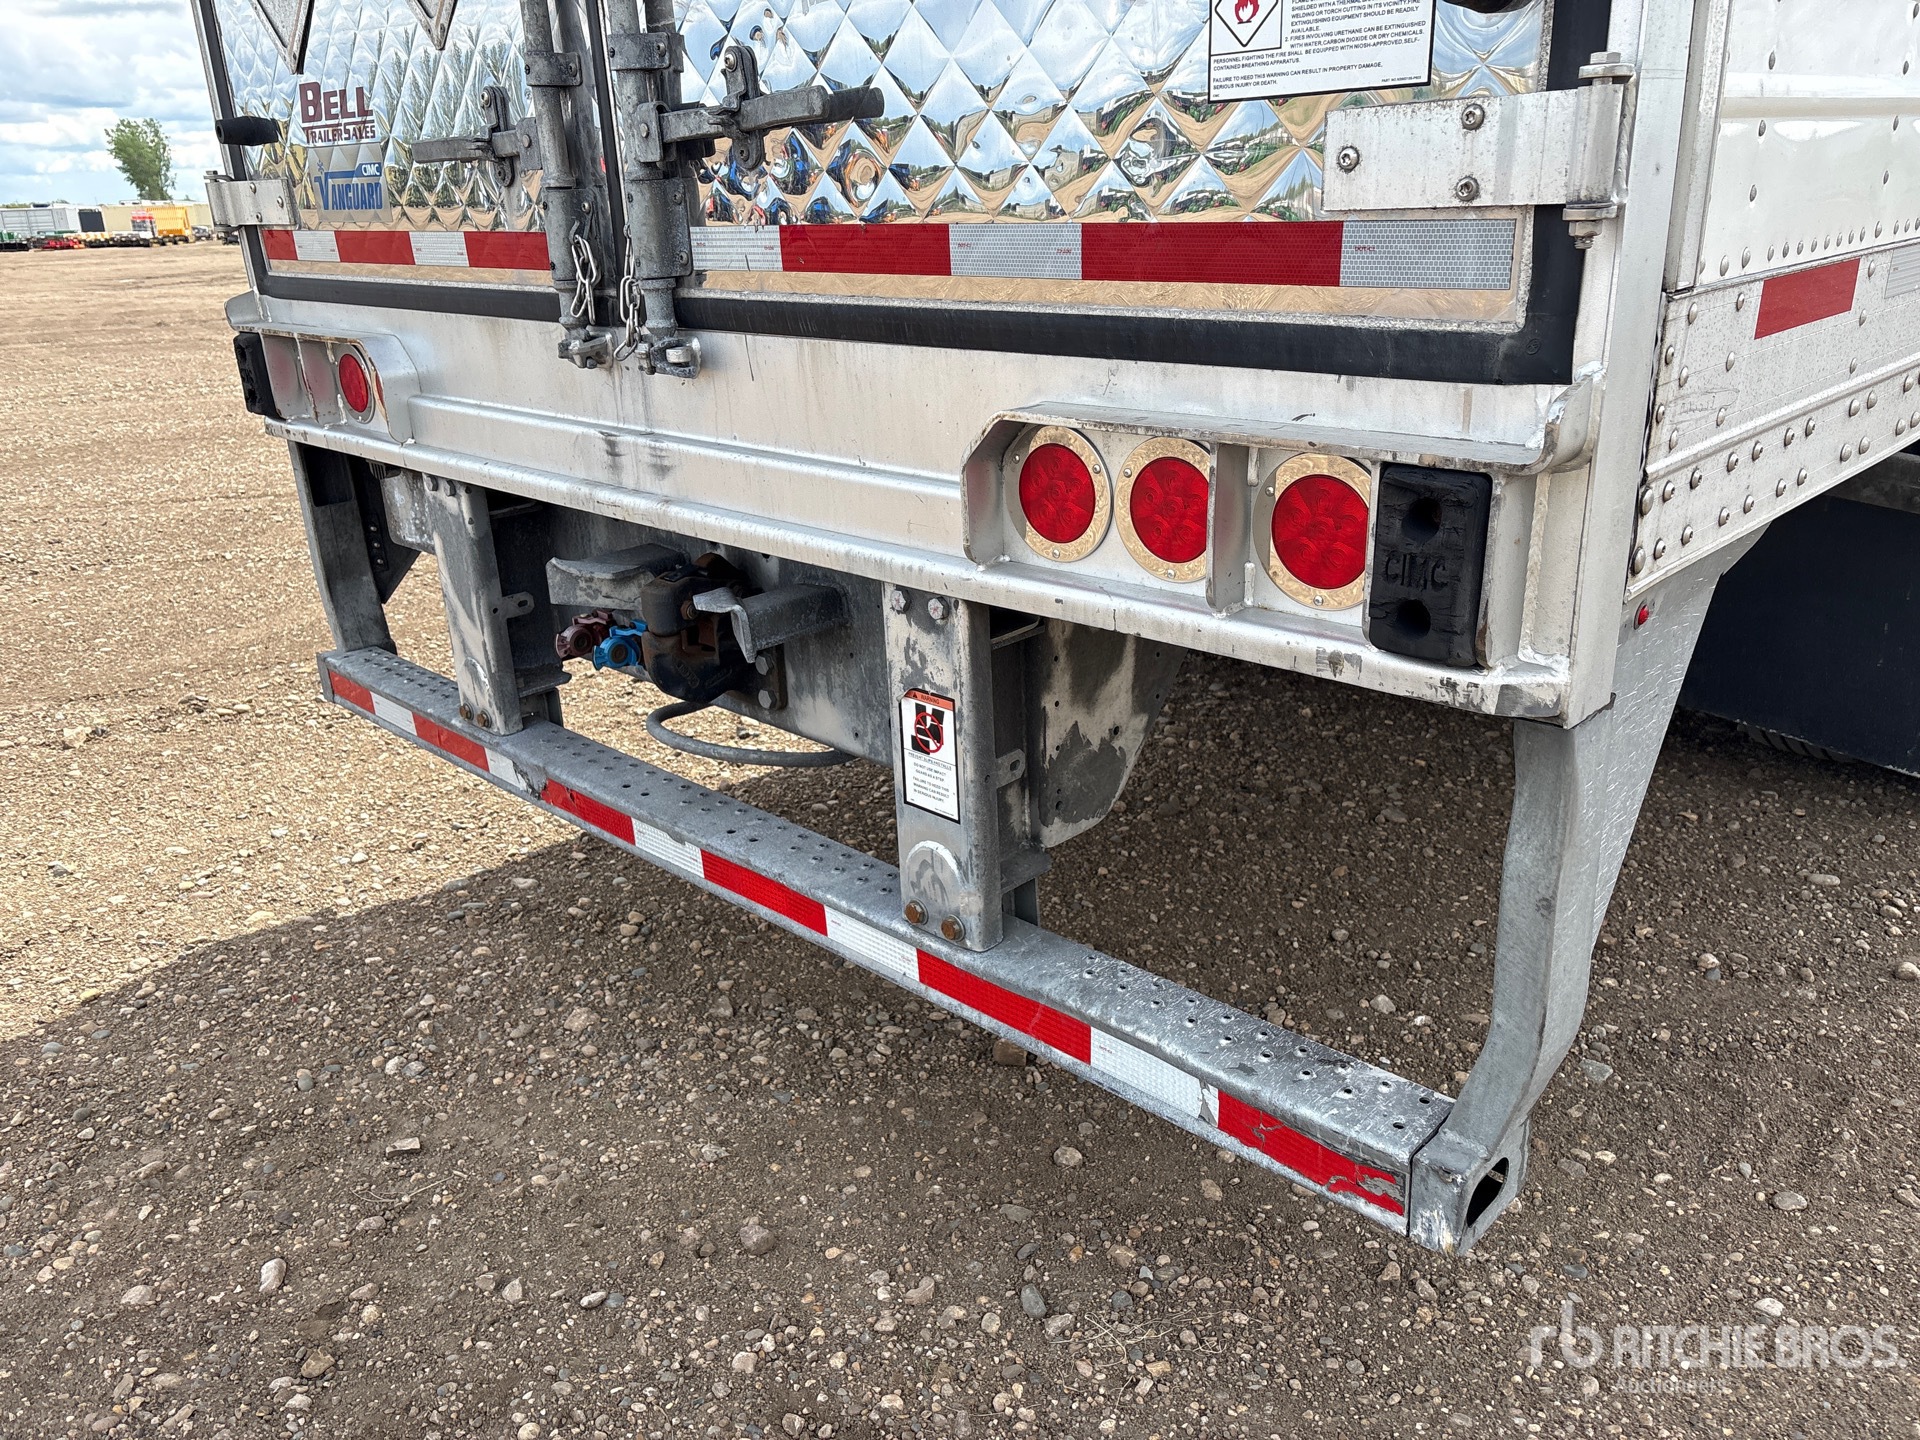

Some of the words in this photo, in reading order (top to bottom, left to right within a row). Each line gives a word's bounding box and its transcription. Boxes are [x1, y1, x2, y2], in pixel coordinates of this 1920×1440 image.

[1291, 17, 1330, 26] EXTINGUISHING
[1332, 13, 1362, 21] EQUIPMENT
[1395, 6, 1419, 14] READILY
[1291, 26, 1321, 34] AVAILABLE.
[1306, 31, 1333, 39] INVOLVING
[1334, 28, 1362, 36] URETHANE
[1385, 20, 1426, 30] EXTINGUISHED
[1391, 29, 1424, 38] CHEMICALS.
[1213, 63, 1243, 71] CONTAINED
[1242, 60, 1269, 69] BREATHING
[1213, 75, 1232, 83] FAILURE
[299, 81, 374, 123] BELL
[361, 164, 380, 176] CIMC
[314, 171, 382, 210] VANGUARD
[1384, 549, 1449, 592] CIMC
[921, 694, 940, 704] WARNING
